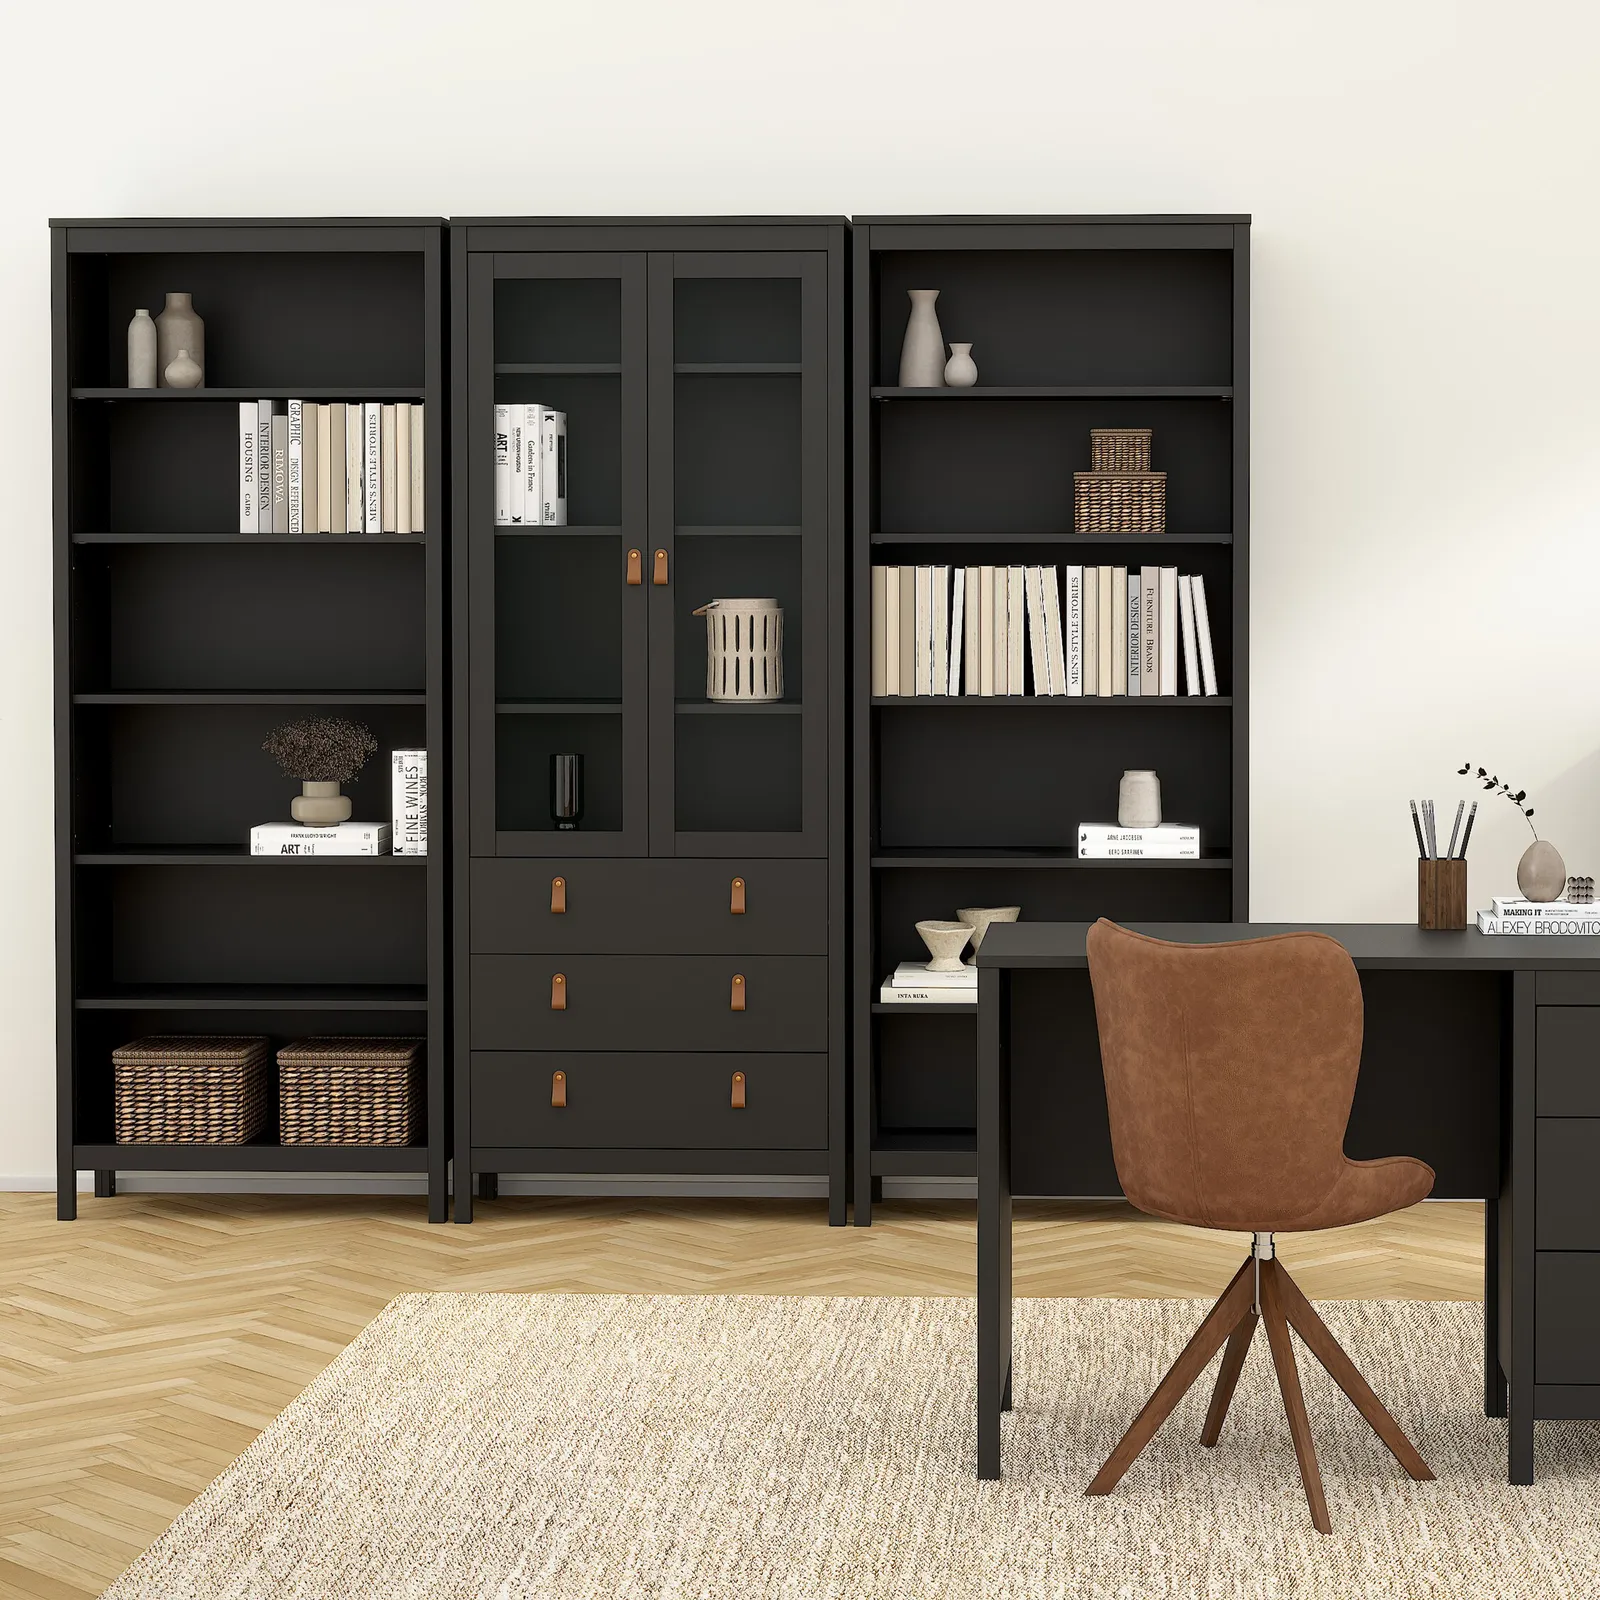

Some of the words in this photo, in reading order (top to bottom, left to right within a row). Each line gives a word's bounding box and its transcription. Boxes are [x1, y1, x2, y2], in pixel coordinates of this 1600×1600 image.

[290, 402, 301, 445] GRAPHIC
[369, 414, 377, 457] STORIES
[496, 433, 508, 452] ART
[245, 433, 253, 483] HOUSING
[260, 422, 269, 470] INTERIOR
[260, 472, 269, 511] DESIGN
[275, 449, 284, 504] RIMOWA
[369, 458, 377, 489] STYLE
[290, 486, 299, 533] REFERENCED
[369, 491, 377, 521] MEN'S
[1131, 596, 1139, 630] DESIGN
[1146, 588, 1154, 634] FURNITURE
[1131, 632, 1139, 676] INTERIOR
[1146, 639, 1154, 673] BRANDS
[406, 766, 418, 808] WINES
[406, 814, 418, 842] FINE
[281, 844, 300, 854] ART
[1487, 921, 1531, 934] ALEXEY
